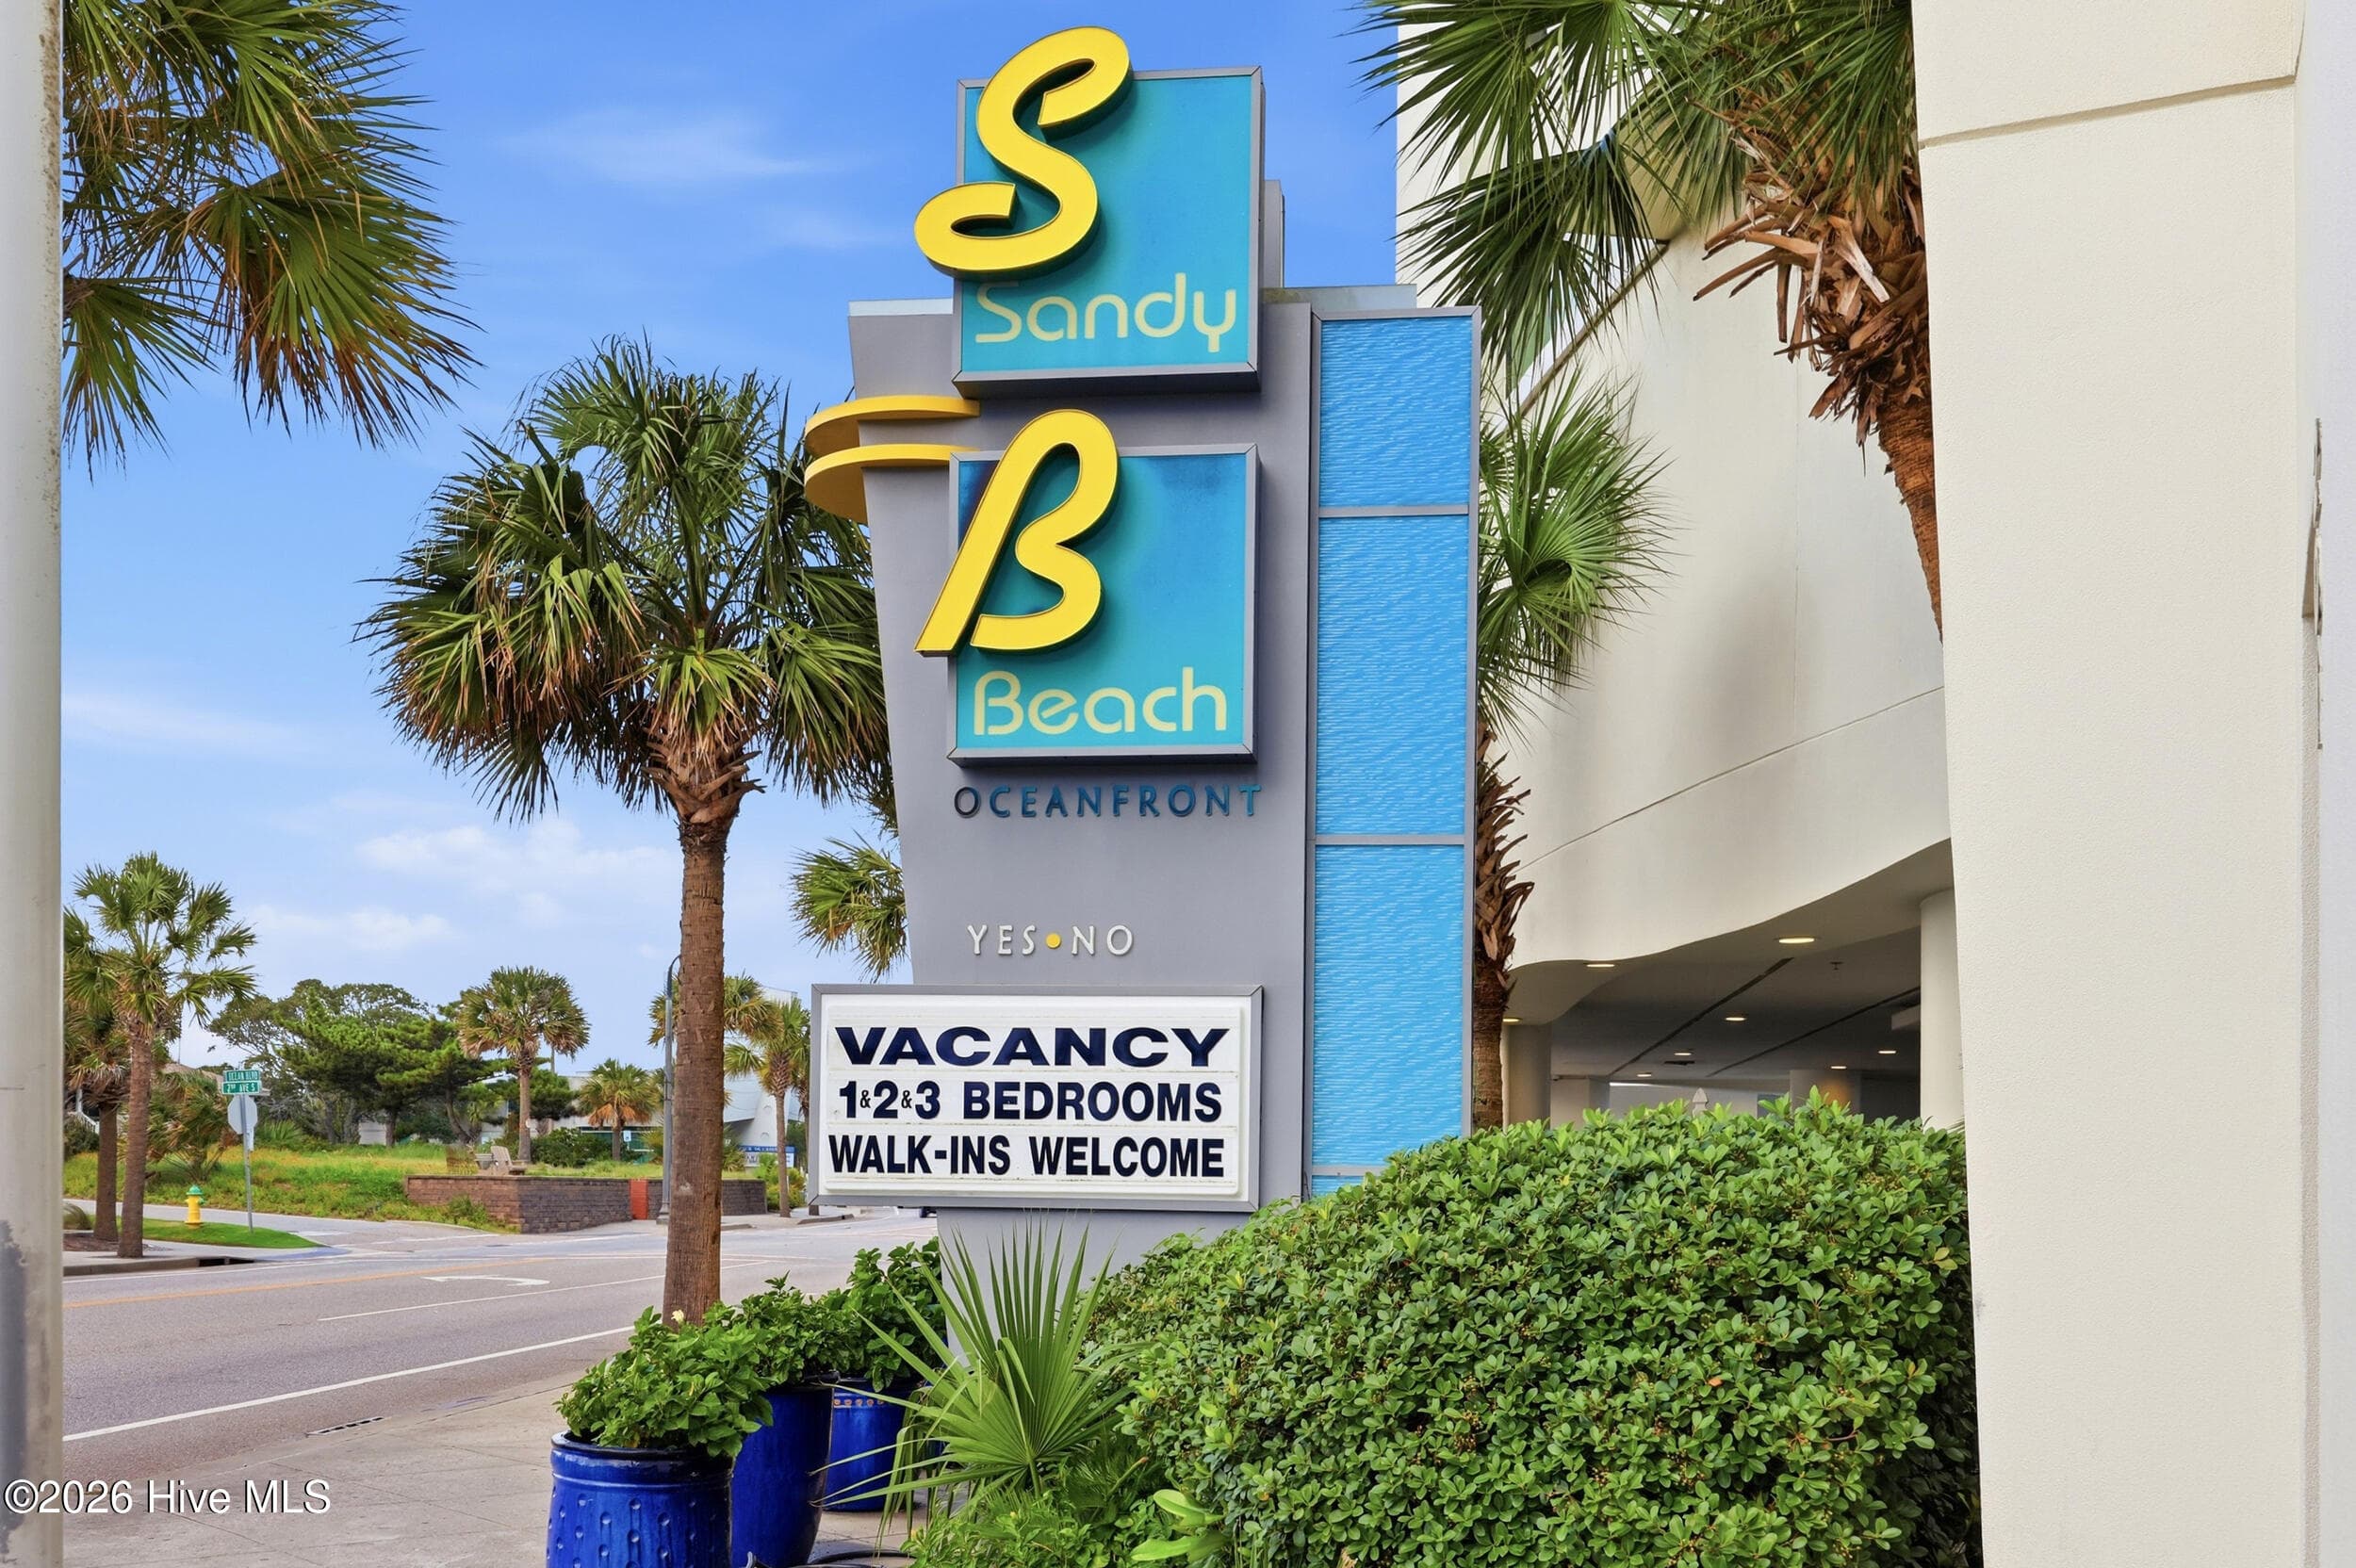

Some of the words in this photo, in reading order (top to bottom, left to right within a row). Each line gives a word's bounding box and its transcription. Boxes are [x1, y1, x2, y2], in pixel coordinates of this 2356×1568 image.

[974, 272, 1236, 353] Sandy
[973, 666, 1227, 736] Beach
[954, 784, 1262, 818] OCEANFRONT
[835, 1026, 1231, 1067] VACANCY
[963, 1081, 1222, 1123] BEDROOMS
[828, 1134, 1011, 1175] WALK-INS
[1029, 1135, 1225, 1178] WELCOME
